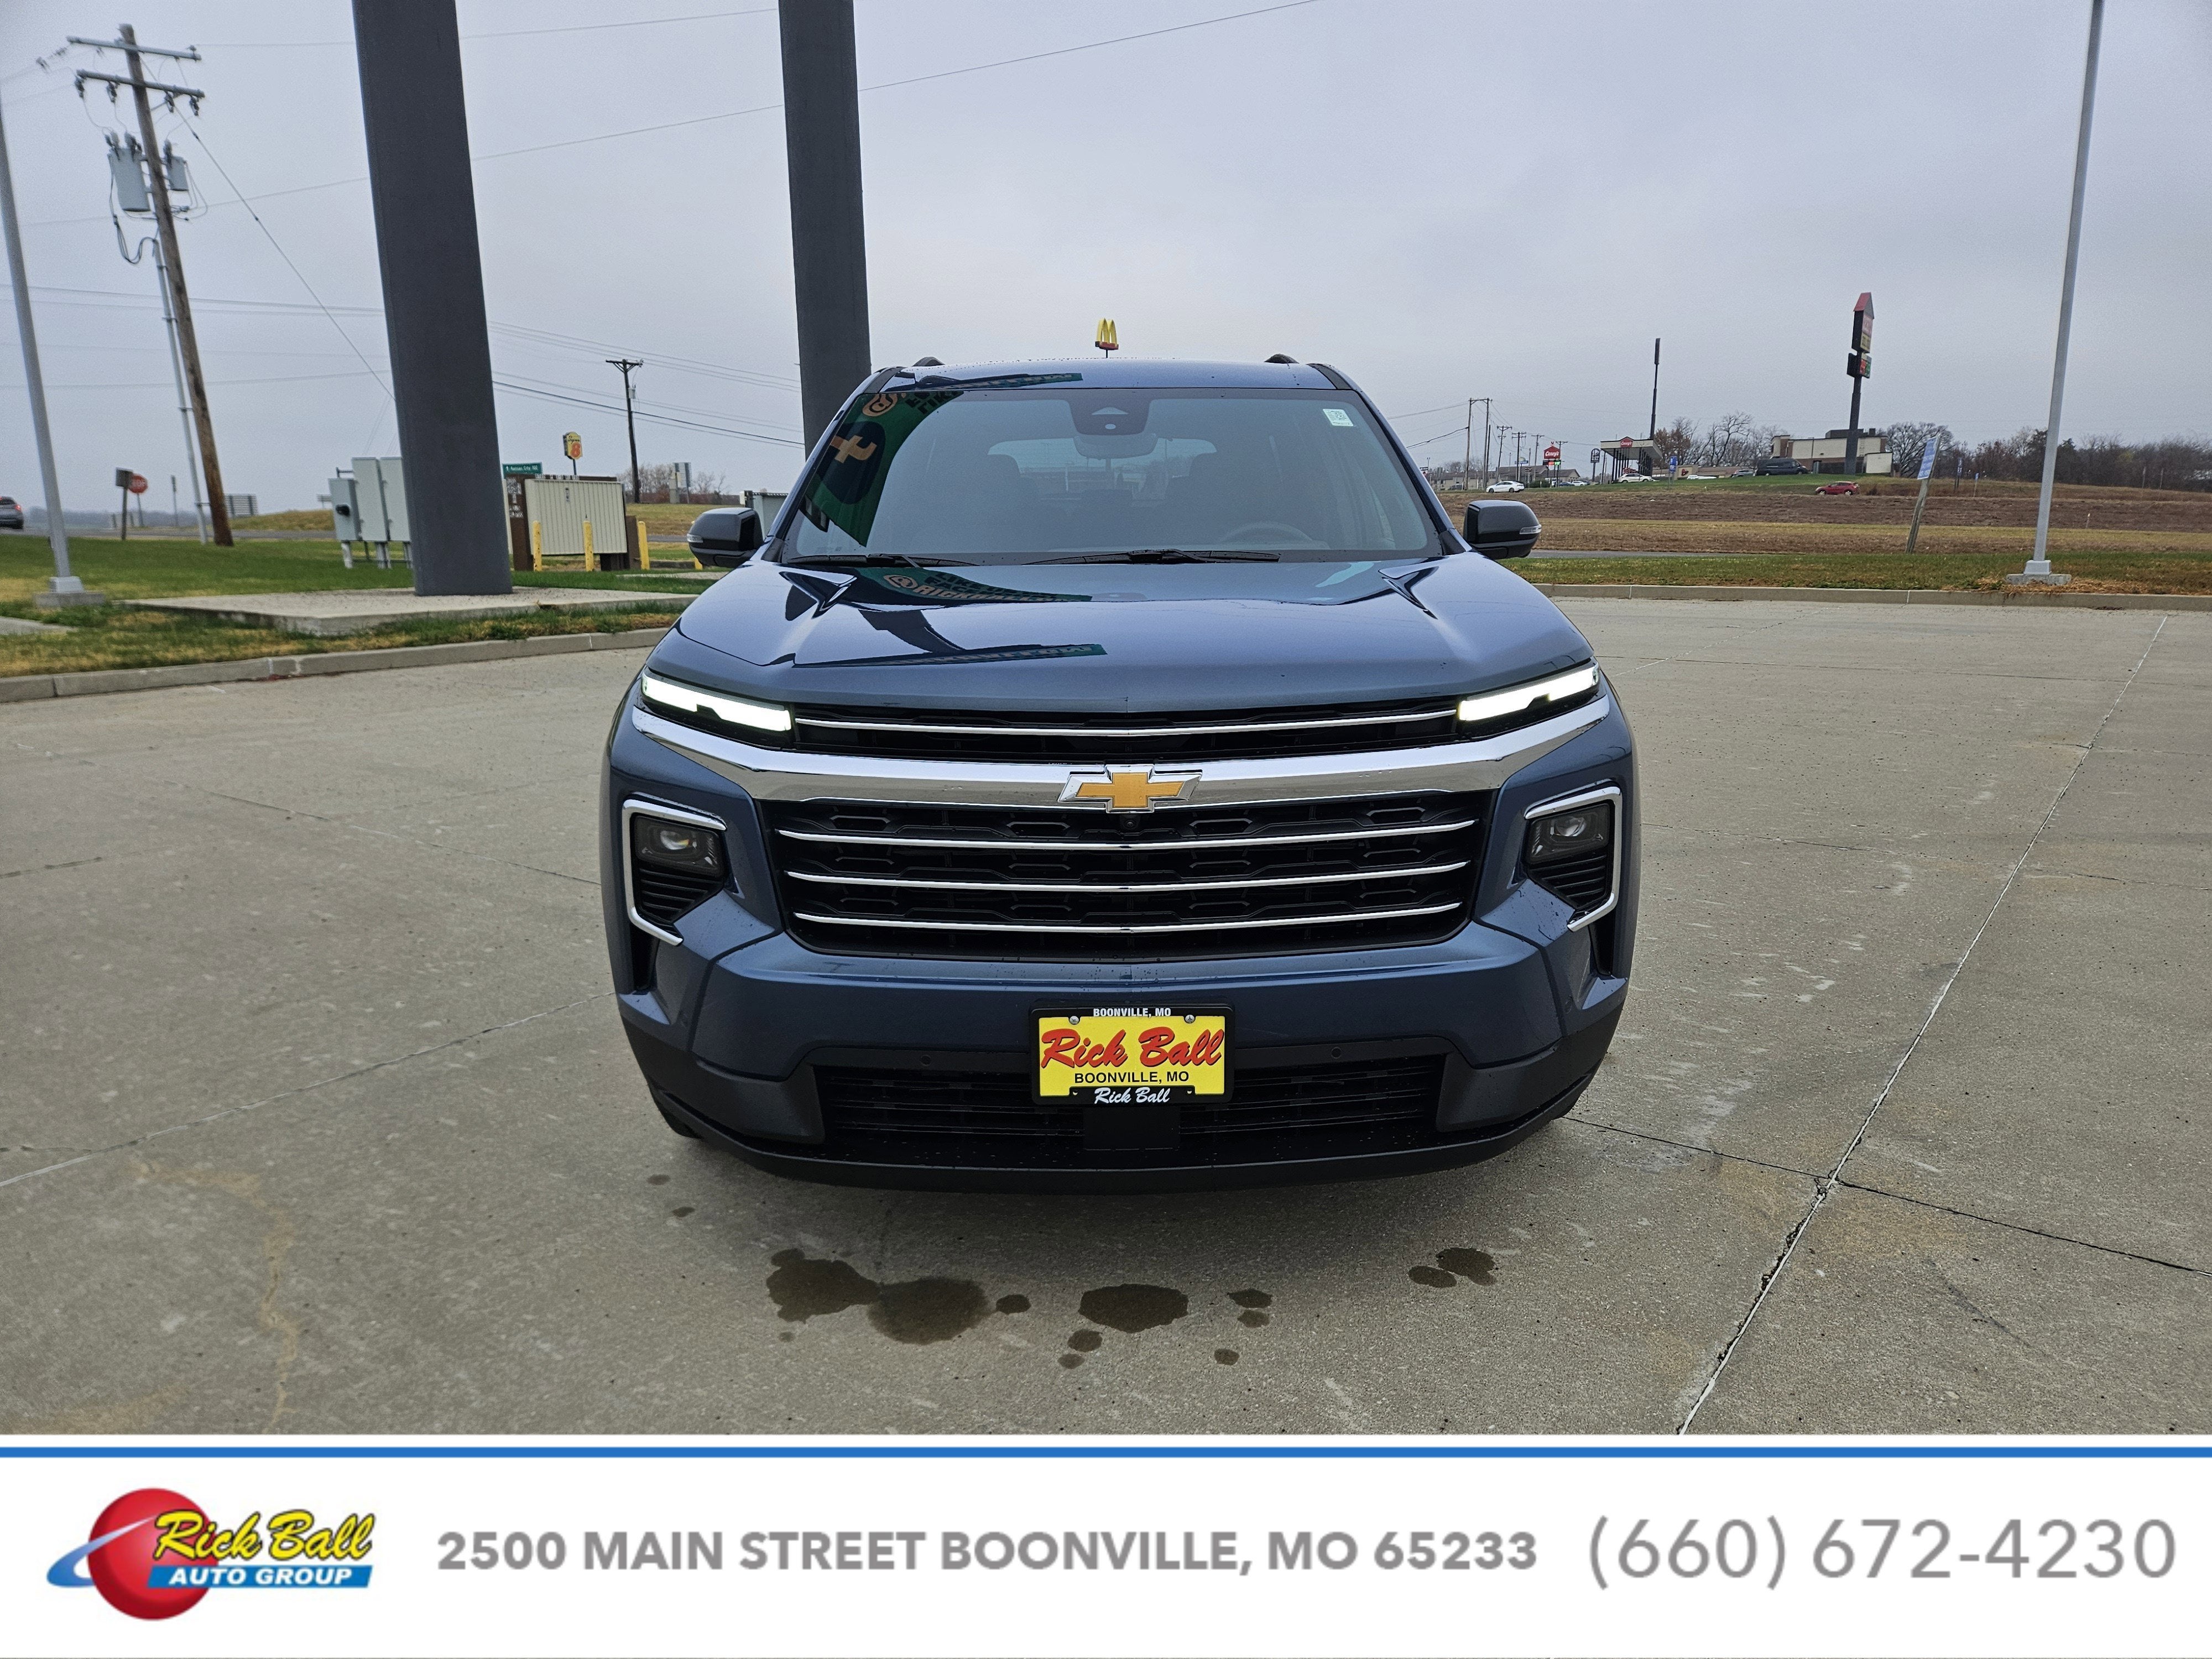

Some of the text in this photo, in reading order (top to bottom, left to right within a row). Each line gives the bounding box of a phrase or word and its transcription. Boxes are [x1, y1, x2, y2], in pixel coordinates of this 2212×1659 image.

[570, 442, 581, 458] 8
[1093, 1008, 1171, 1018] BOONVILLE, MO
[1041, 1026, 1225, 1068] Rick Ball
[1074, 1071, 1189, 1084] BOONVILLE, MO
[1094, 1088, 1171, 1104] Rick Ball
